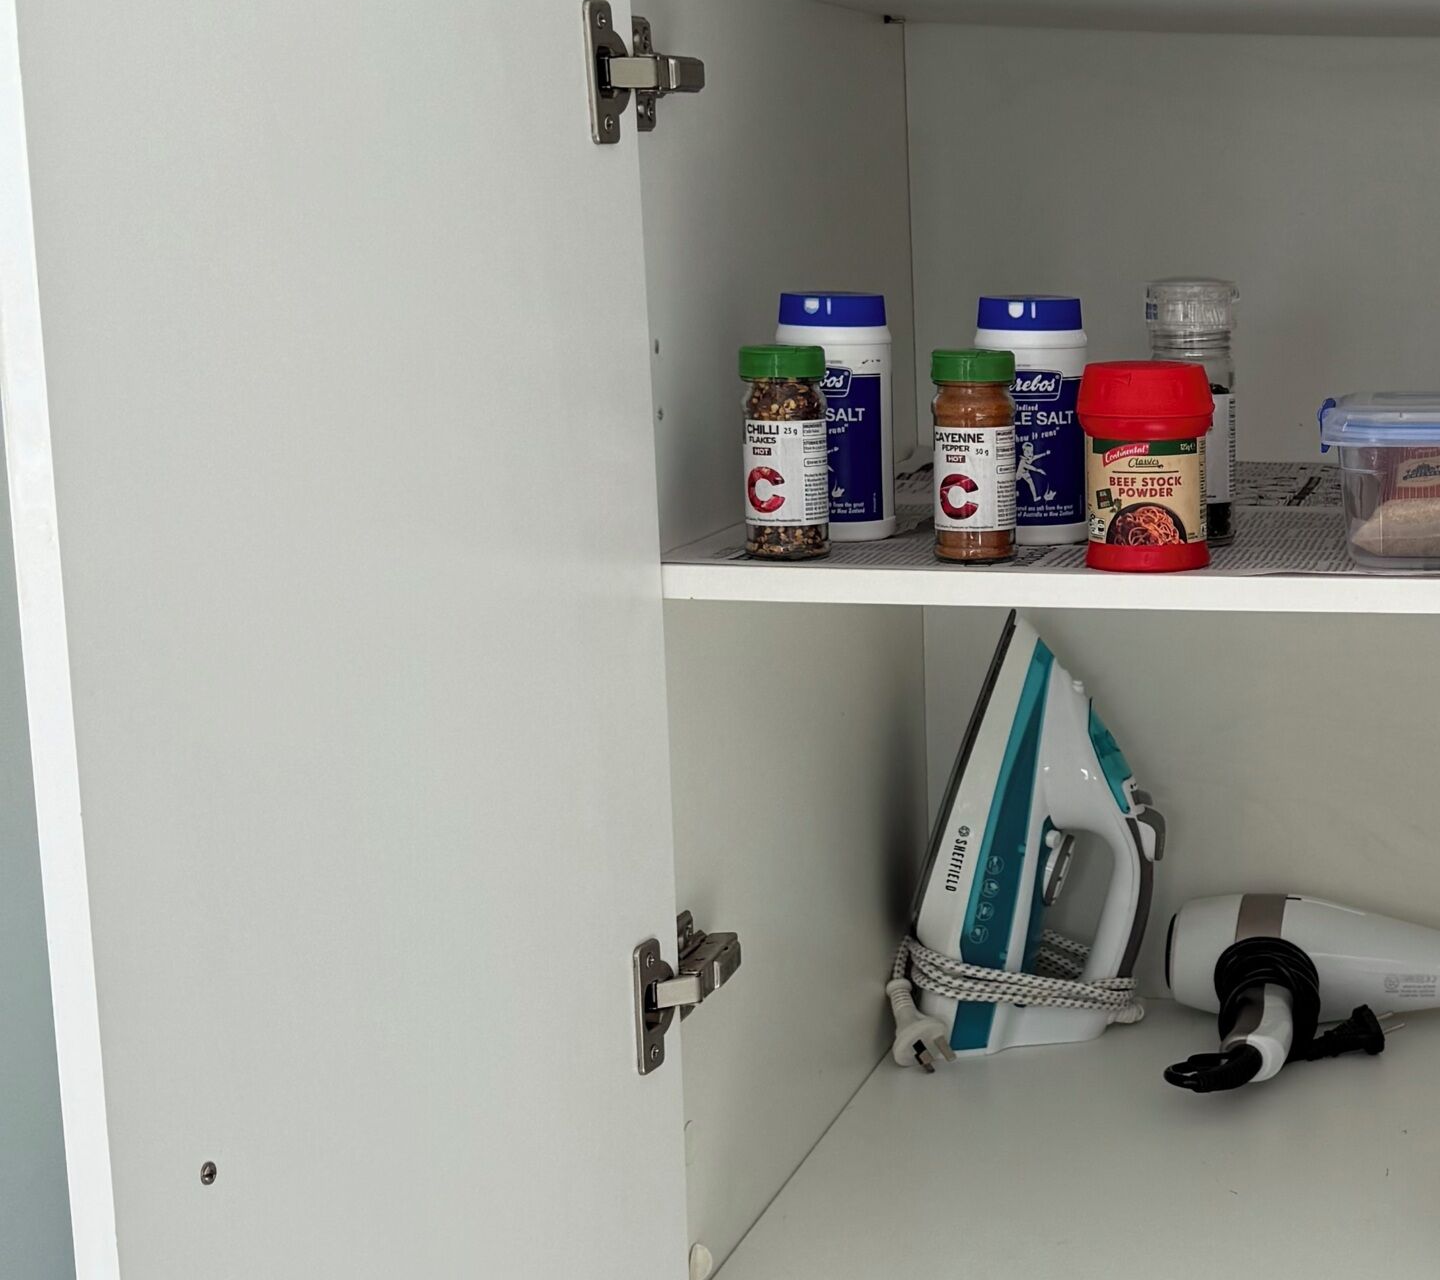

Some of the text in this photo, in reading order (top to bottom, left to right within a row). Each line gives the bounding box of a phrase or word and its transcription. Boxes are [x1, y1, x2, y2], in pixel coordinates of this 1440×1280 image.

[825, 407, 865, 422] SALT
[1036, 410, 1074, 425] SALT
[747, 424, 779, 435] CHILLI
[749, 436, 776, 444] FLAKES
[936, 431, 985, 443] CAYENNE
[942, 444, 970, 452] PEPPER
[1105, 444, 1146, 463] Continental
[1128, 457, 1160, 468] Classics
[1109, 476, 1182, 486] BEEF STOCK
[748, 466, 785, 513] C
[1118, 487, 1174, 497] POWDER
[940, 473, 979, 520] C
[945, 838, 968, 892] SHEFFIELD
